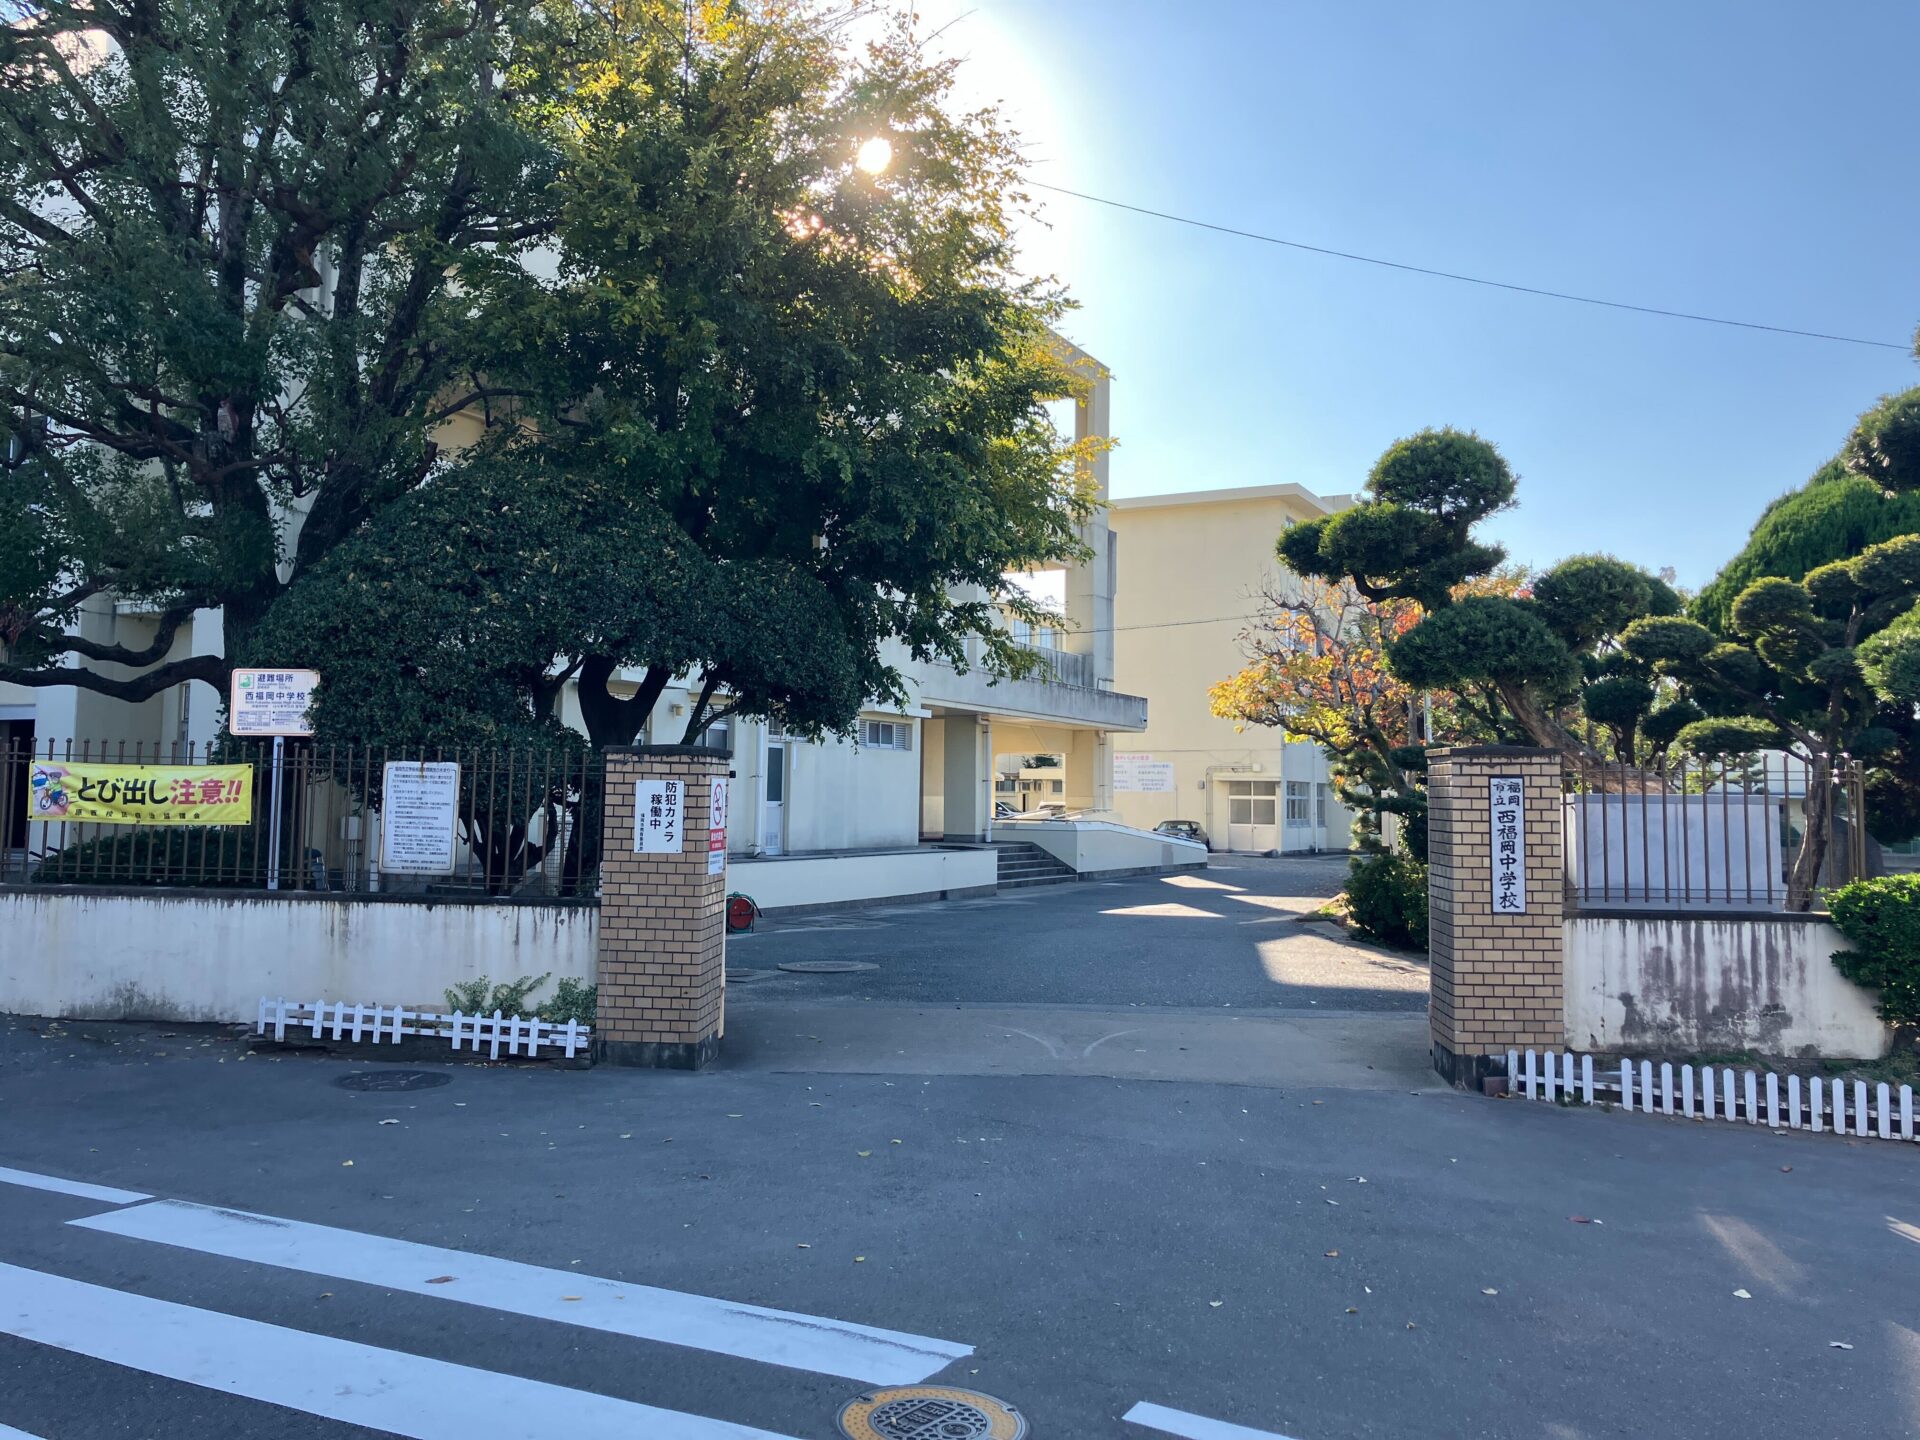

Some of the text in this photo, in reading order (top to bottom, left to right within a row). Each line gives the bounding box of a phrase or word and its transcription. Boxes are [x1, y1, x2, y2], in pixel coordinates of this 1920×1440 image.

[245, 692, 305, 700] 西福岡中学校
[257, 674, 294, 682] 避難場所
[650, 794, 662, 830] 稼働中
[664, 781, 678, 843] 防犯カメラ
[1496, 810, 1521, 910] 西福岡中学校
